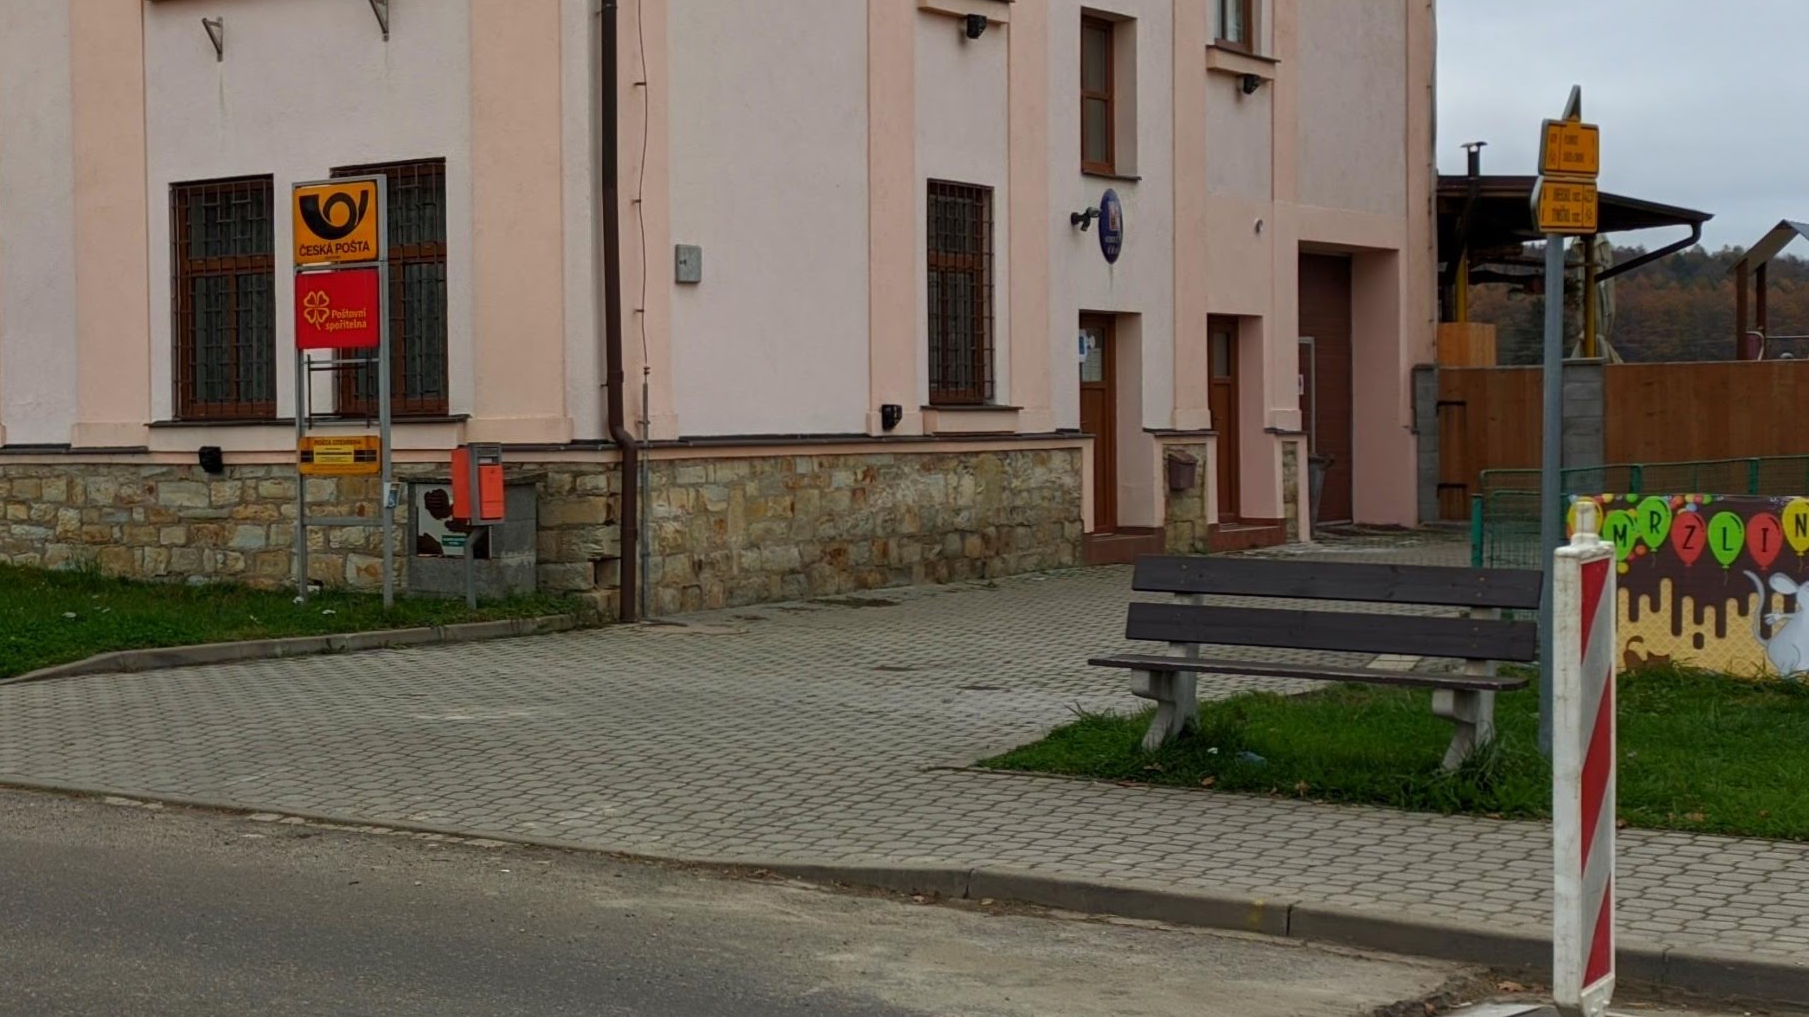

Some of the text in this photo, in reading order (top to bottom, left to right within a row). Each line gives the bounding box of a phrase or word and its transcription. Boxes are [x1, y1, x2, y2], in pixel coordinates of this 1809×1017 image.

[299, 239, 370, 256] ČESKÁ POŠTA
[332, 308, 367, 319] Poštovní
[325, 319, 367, 332] spořitelna
[1612, 510, 1809, 553] MRZLIN
